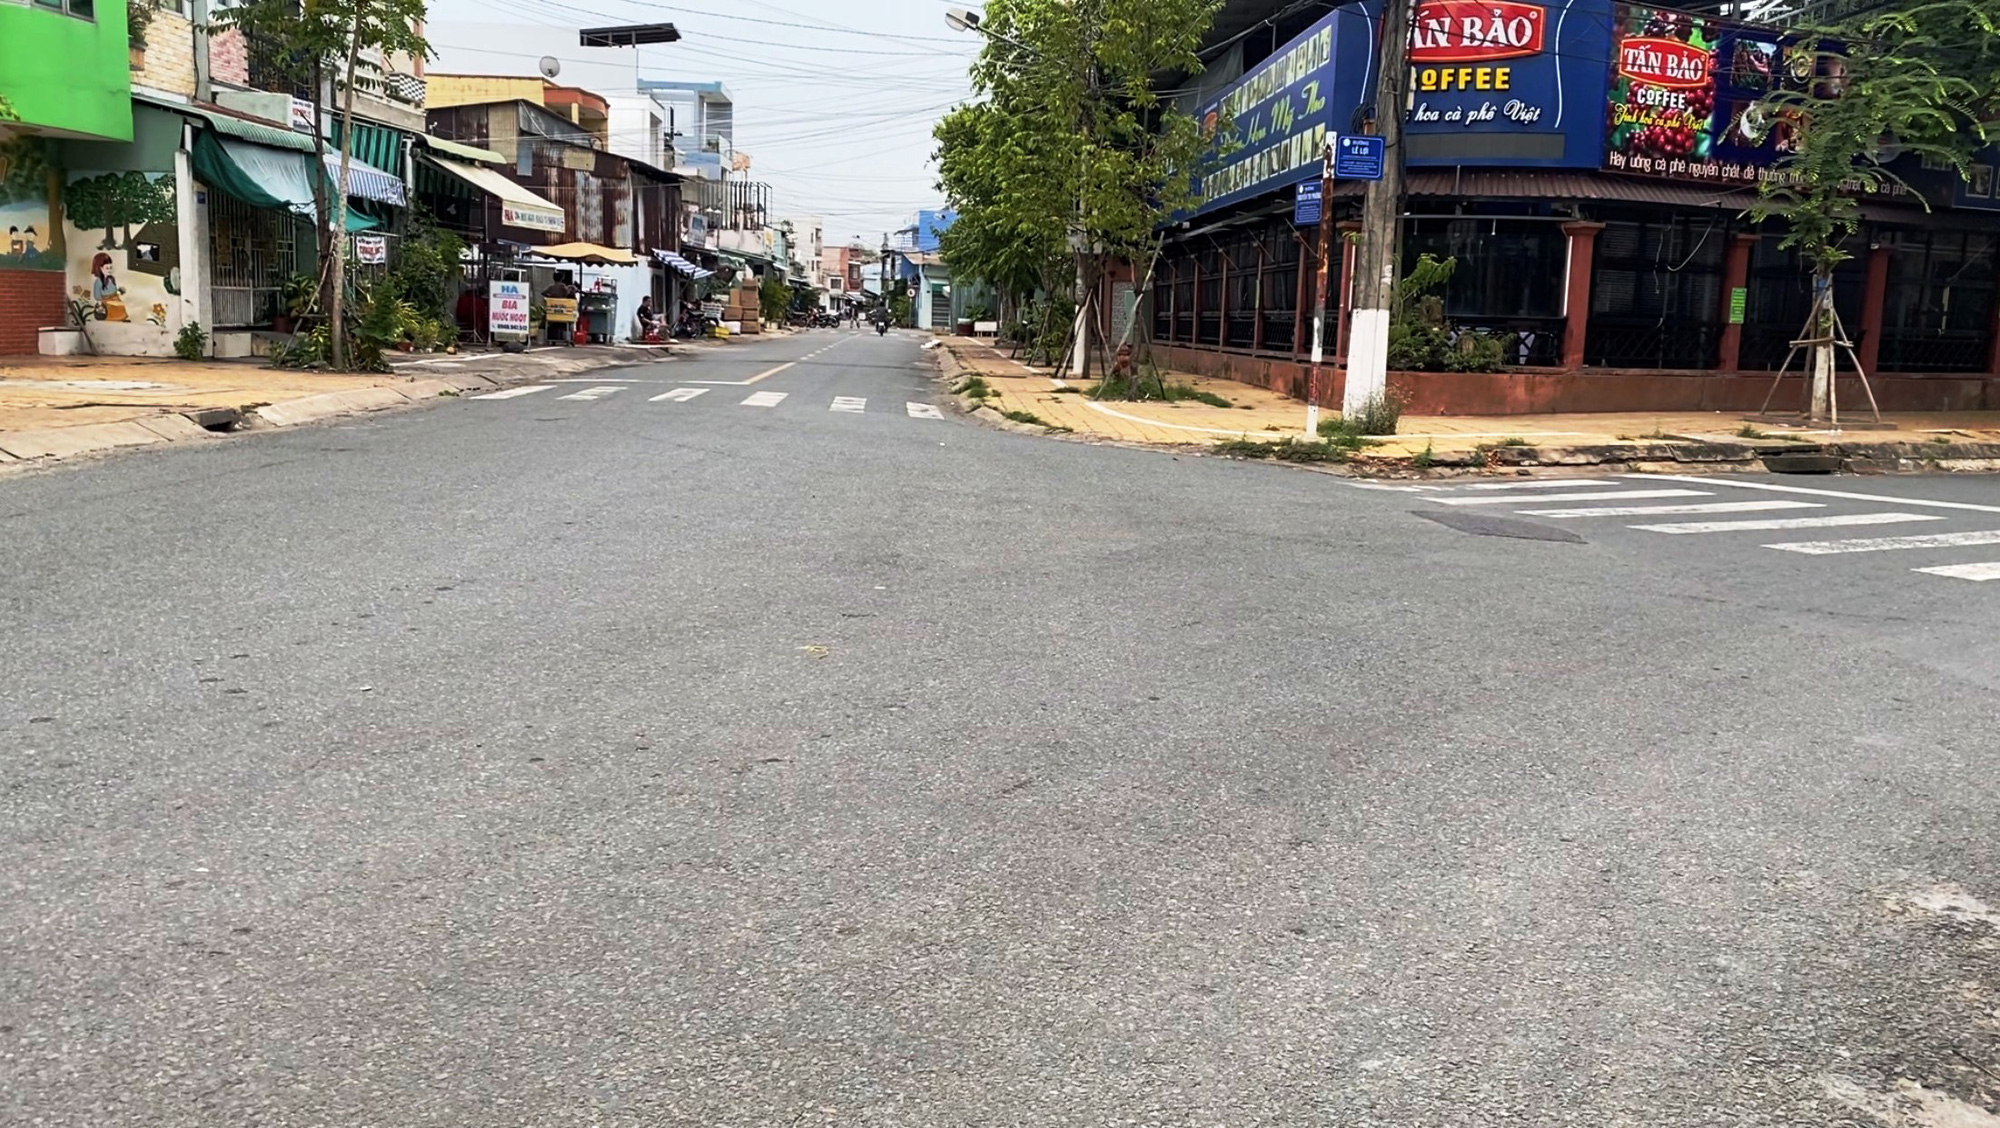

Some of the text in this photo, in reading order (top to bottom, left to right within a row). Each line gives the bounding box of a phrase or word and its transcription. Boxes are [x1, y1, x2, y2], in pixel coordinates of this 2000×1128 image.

[1405, 9, 1533, 48] ẤN BẢO
[1624, 45, 1703, 81] TẤN BẢO
[1420, 68, 1511, 91] OFFEE
[1637, 88, 1685, 109] COFFEE
[1415, 102, 1439, 121] hoa
[1445, 106, 1462, 121] cà
[1465, 101, 1497, 125] phê
[1503, 99, 1540, 124] Việt
[1655, 157, 1666, 171] cà
[1670, 158, 1685, 174] phê
[1689, 162, 1718, 178] nguyên
